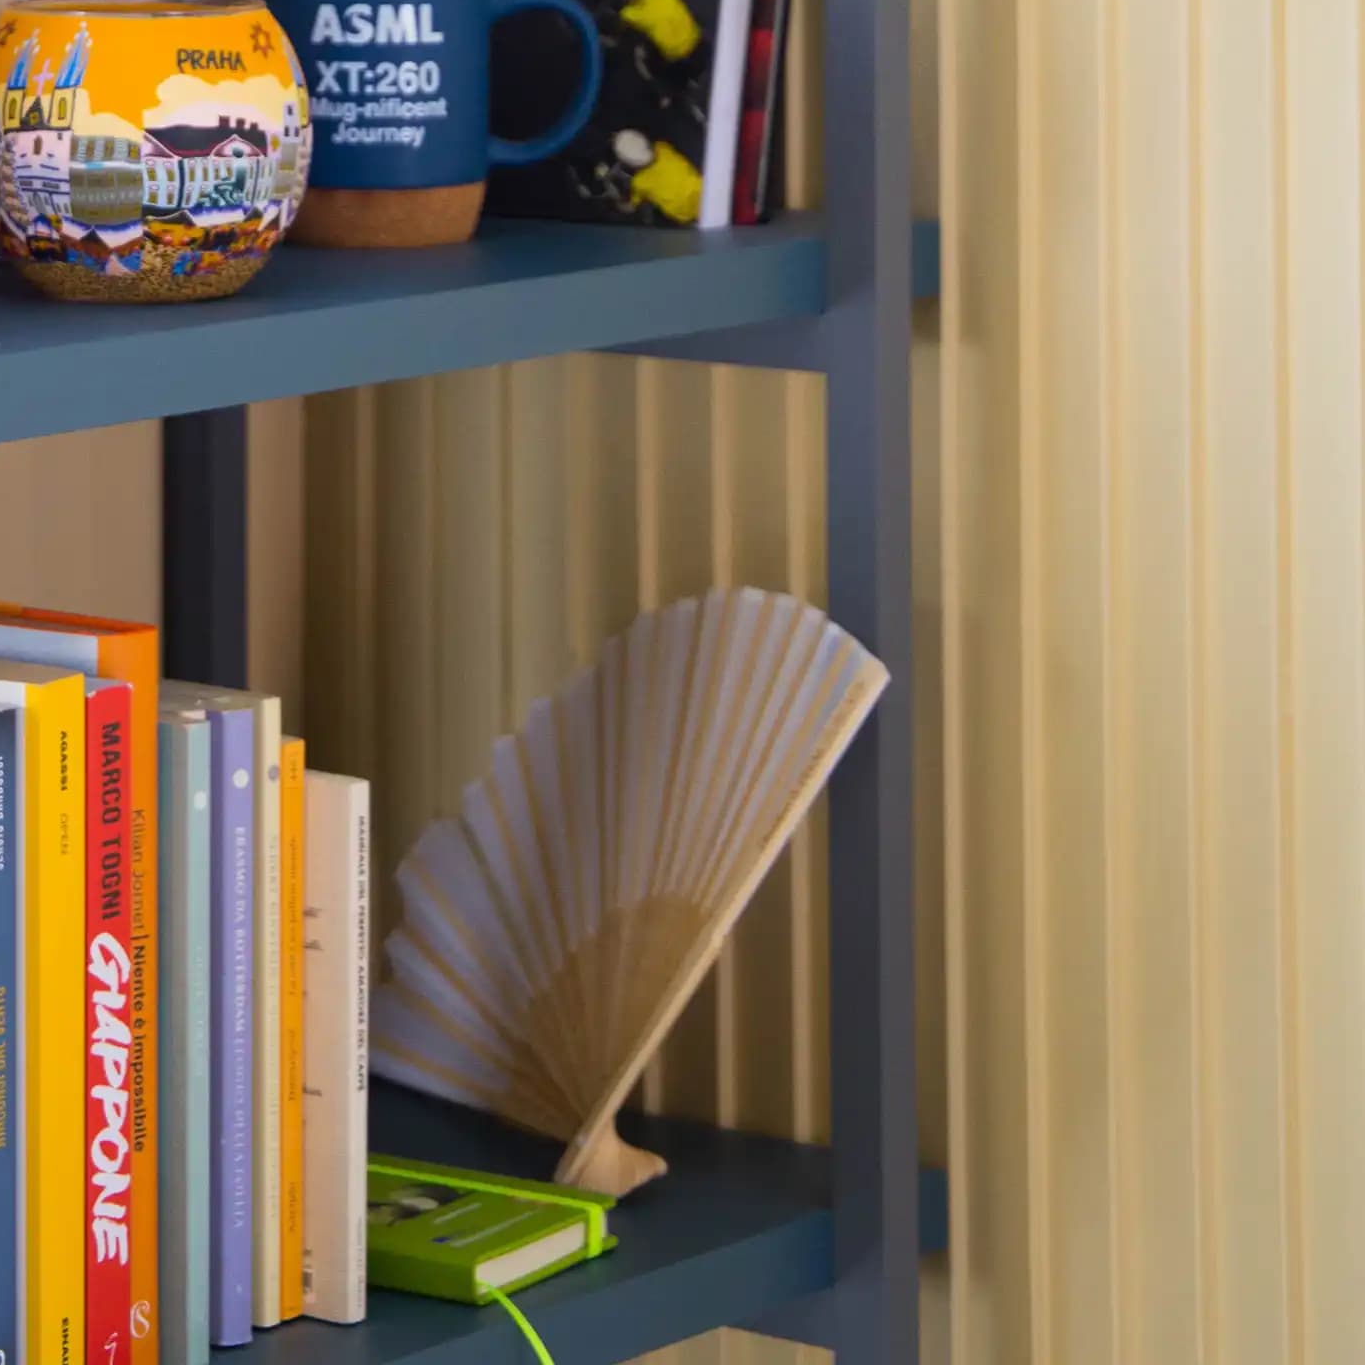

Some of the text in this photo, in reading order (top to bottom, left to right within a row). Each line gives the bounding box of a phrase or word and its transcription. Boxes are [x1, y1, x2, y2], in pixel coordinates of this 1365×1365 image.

[311, 3, 443, 46] ASML
[176, 48, 246, 73] PRAHA
[317, 61, 438, 95] XT:260
[332, 123, 425, 148] Journey
[60, 730, 69, 791] AGASSI
[101, 722, 122, 920] MARCO TOGNI
[131, 809, 146, 929] Kilian Jornet
[235, 826, 246, 894] ERASMO
[131, 945, 148, 1152] Niente è impossibile
[88, 933, 133, 1266] GIAPPONE
